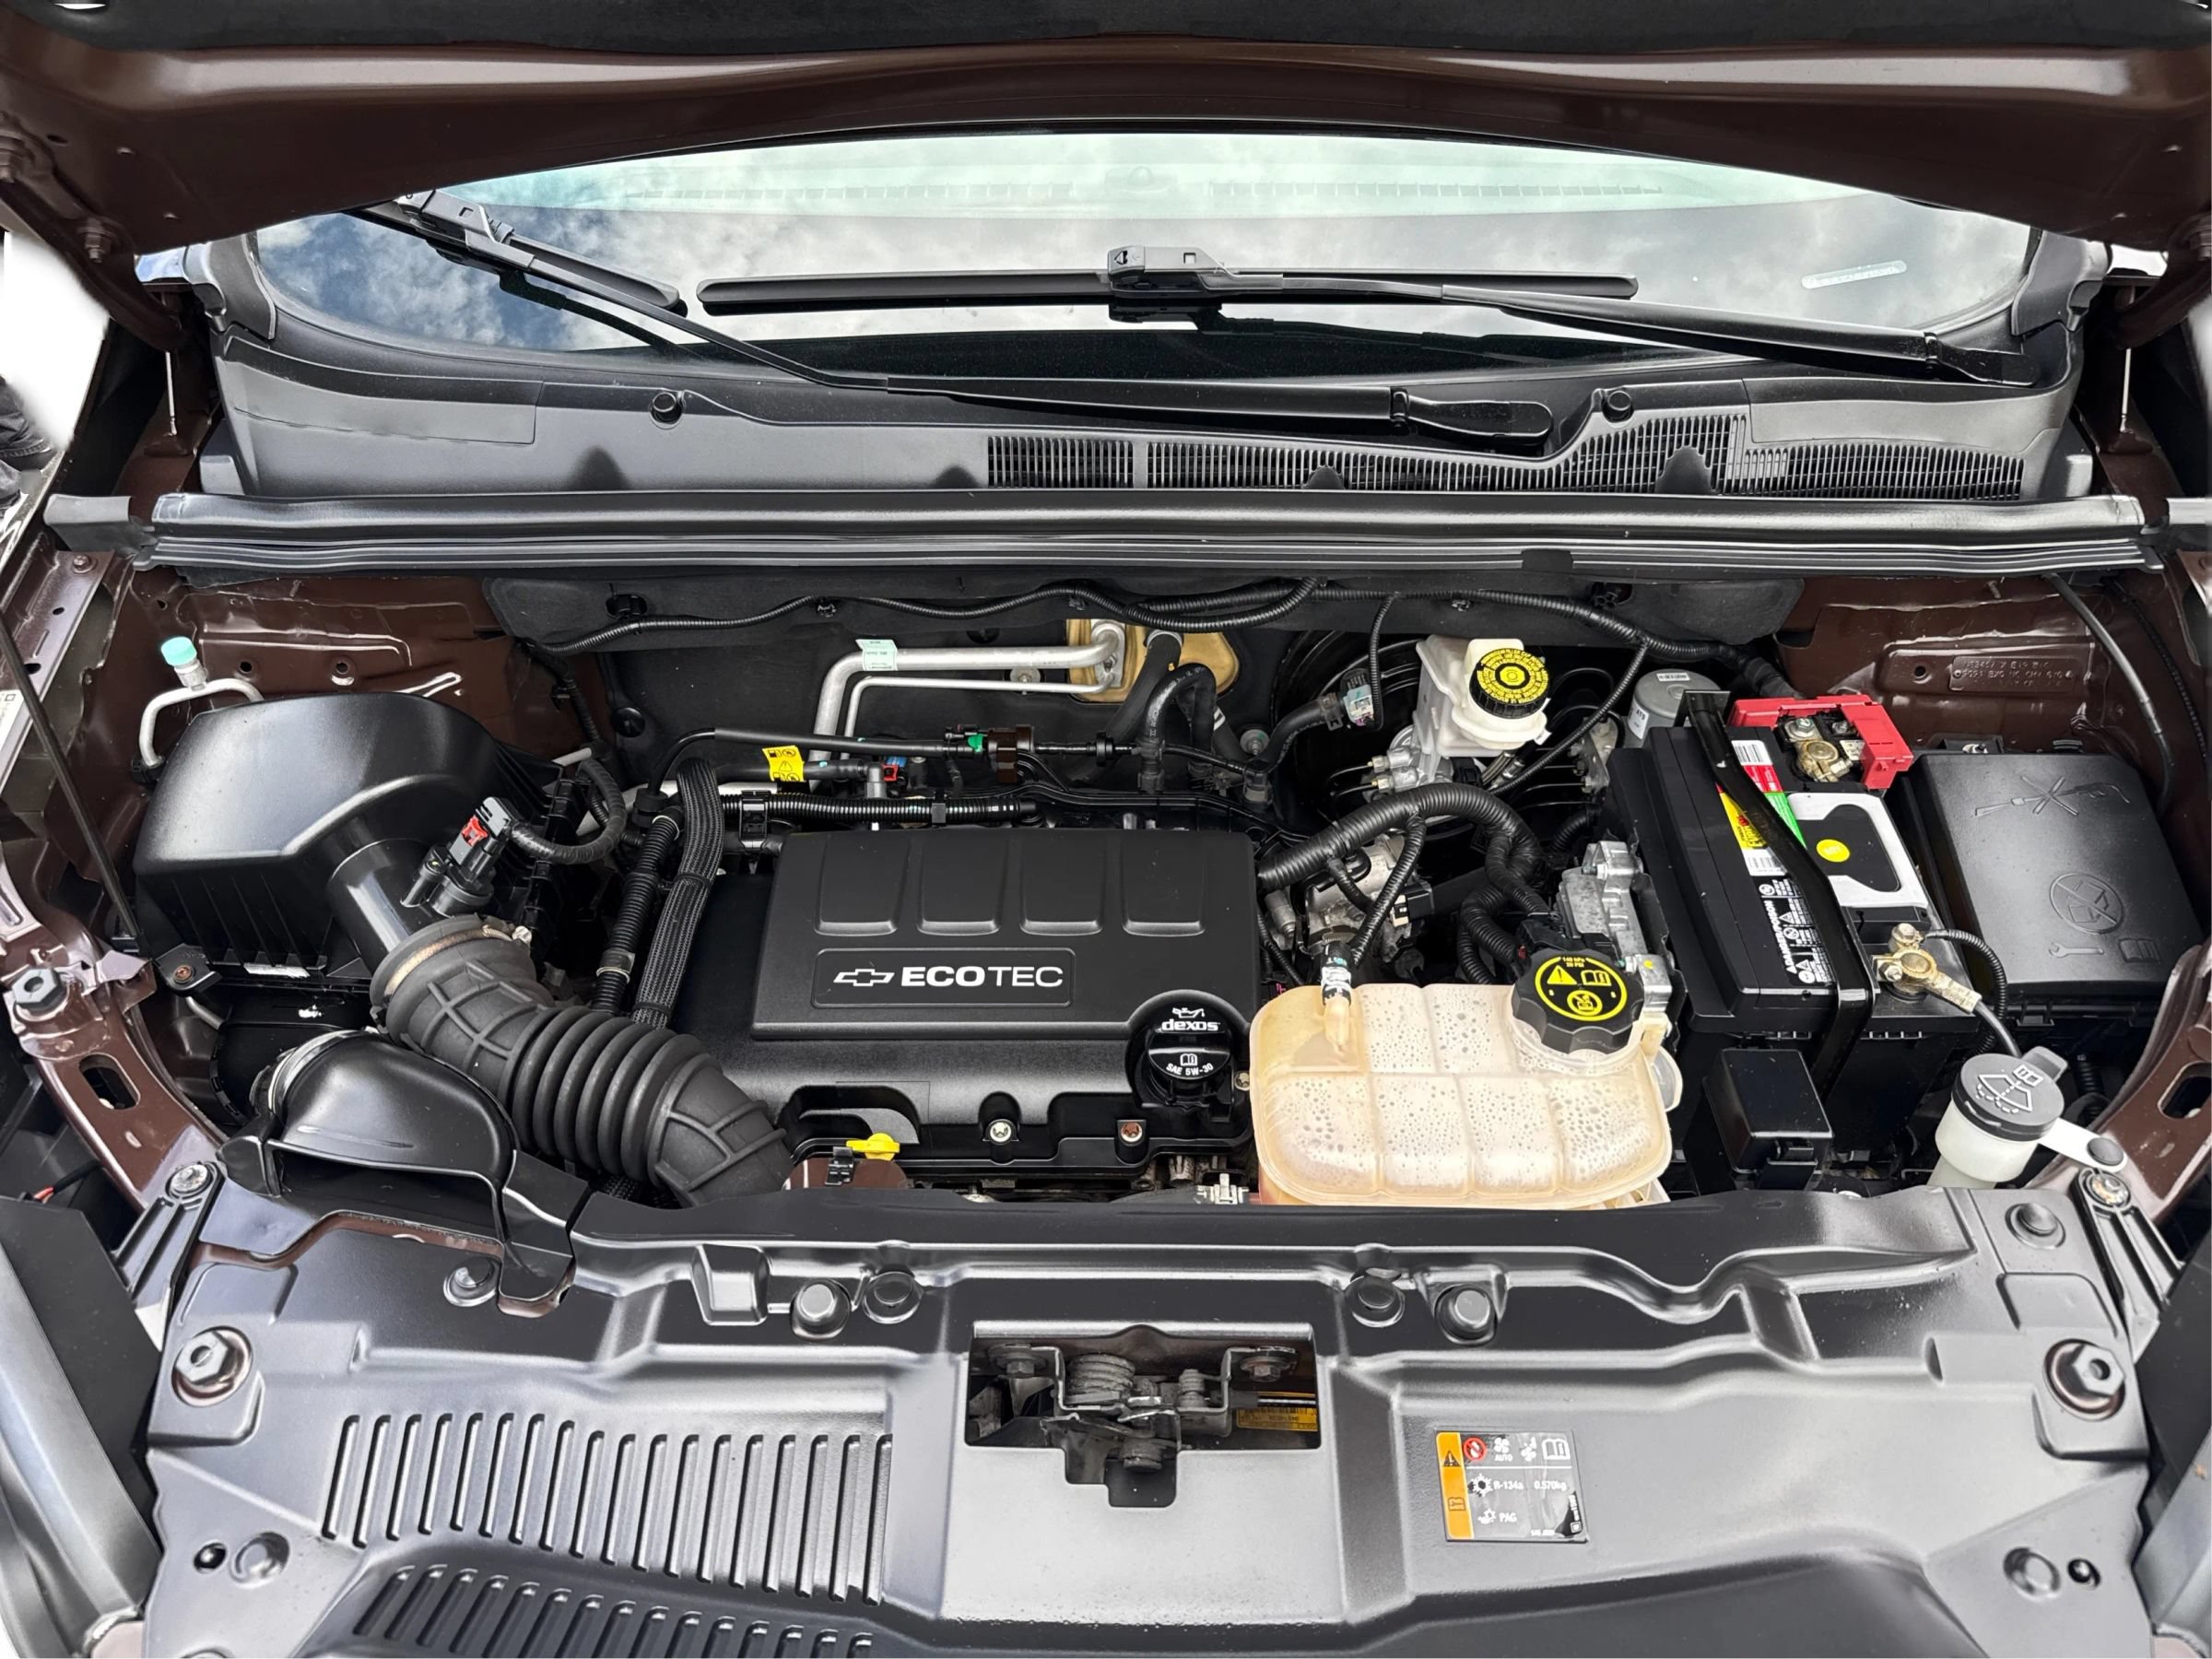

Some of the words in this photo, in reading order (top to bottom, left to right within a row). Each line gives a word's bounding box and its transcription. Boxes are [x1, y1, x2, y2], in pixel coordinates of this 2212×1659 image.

[901, 966, 1064, 987] ECOTEC
[1161, 1018, 1219, 1031] dexos
[1166, 1063, 1182, 1076] SAE
[1185, 1063, 1214, 1076] 5W-30
[1495, 1453, 1513, 1462] AUTO
[1493, 1480, 1524, 1490] R-134a
[1534, 1480, 1567, 1491] 0.570kg
[1499, 1512, 1518, 1523] PAG
